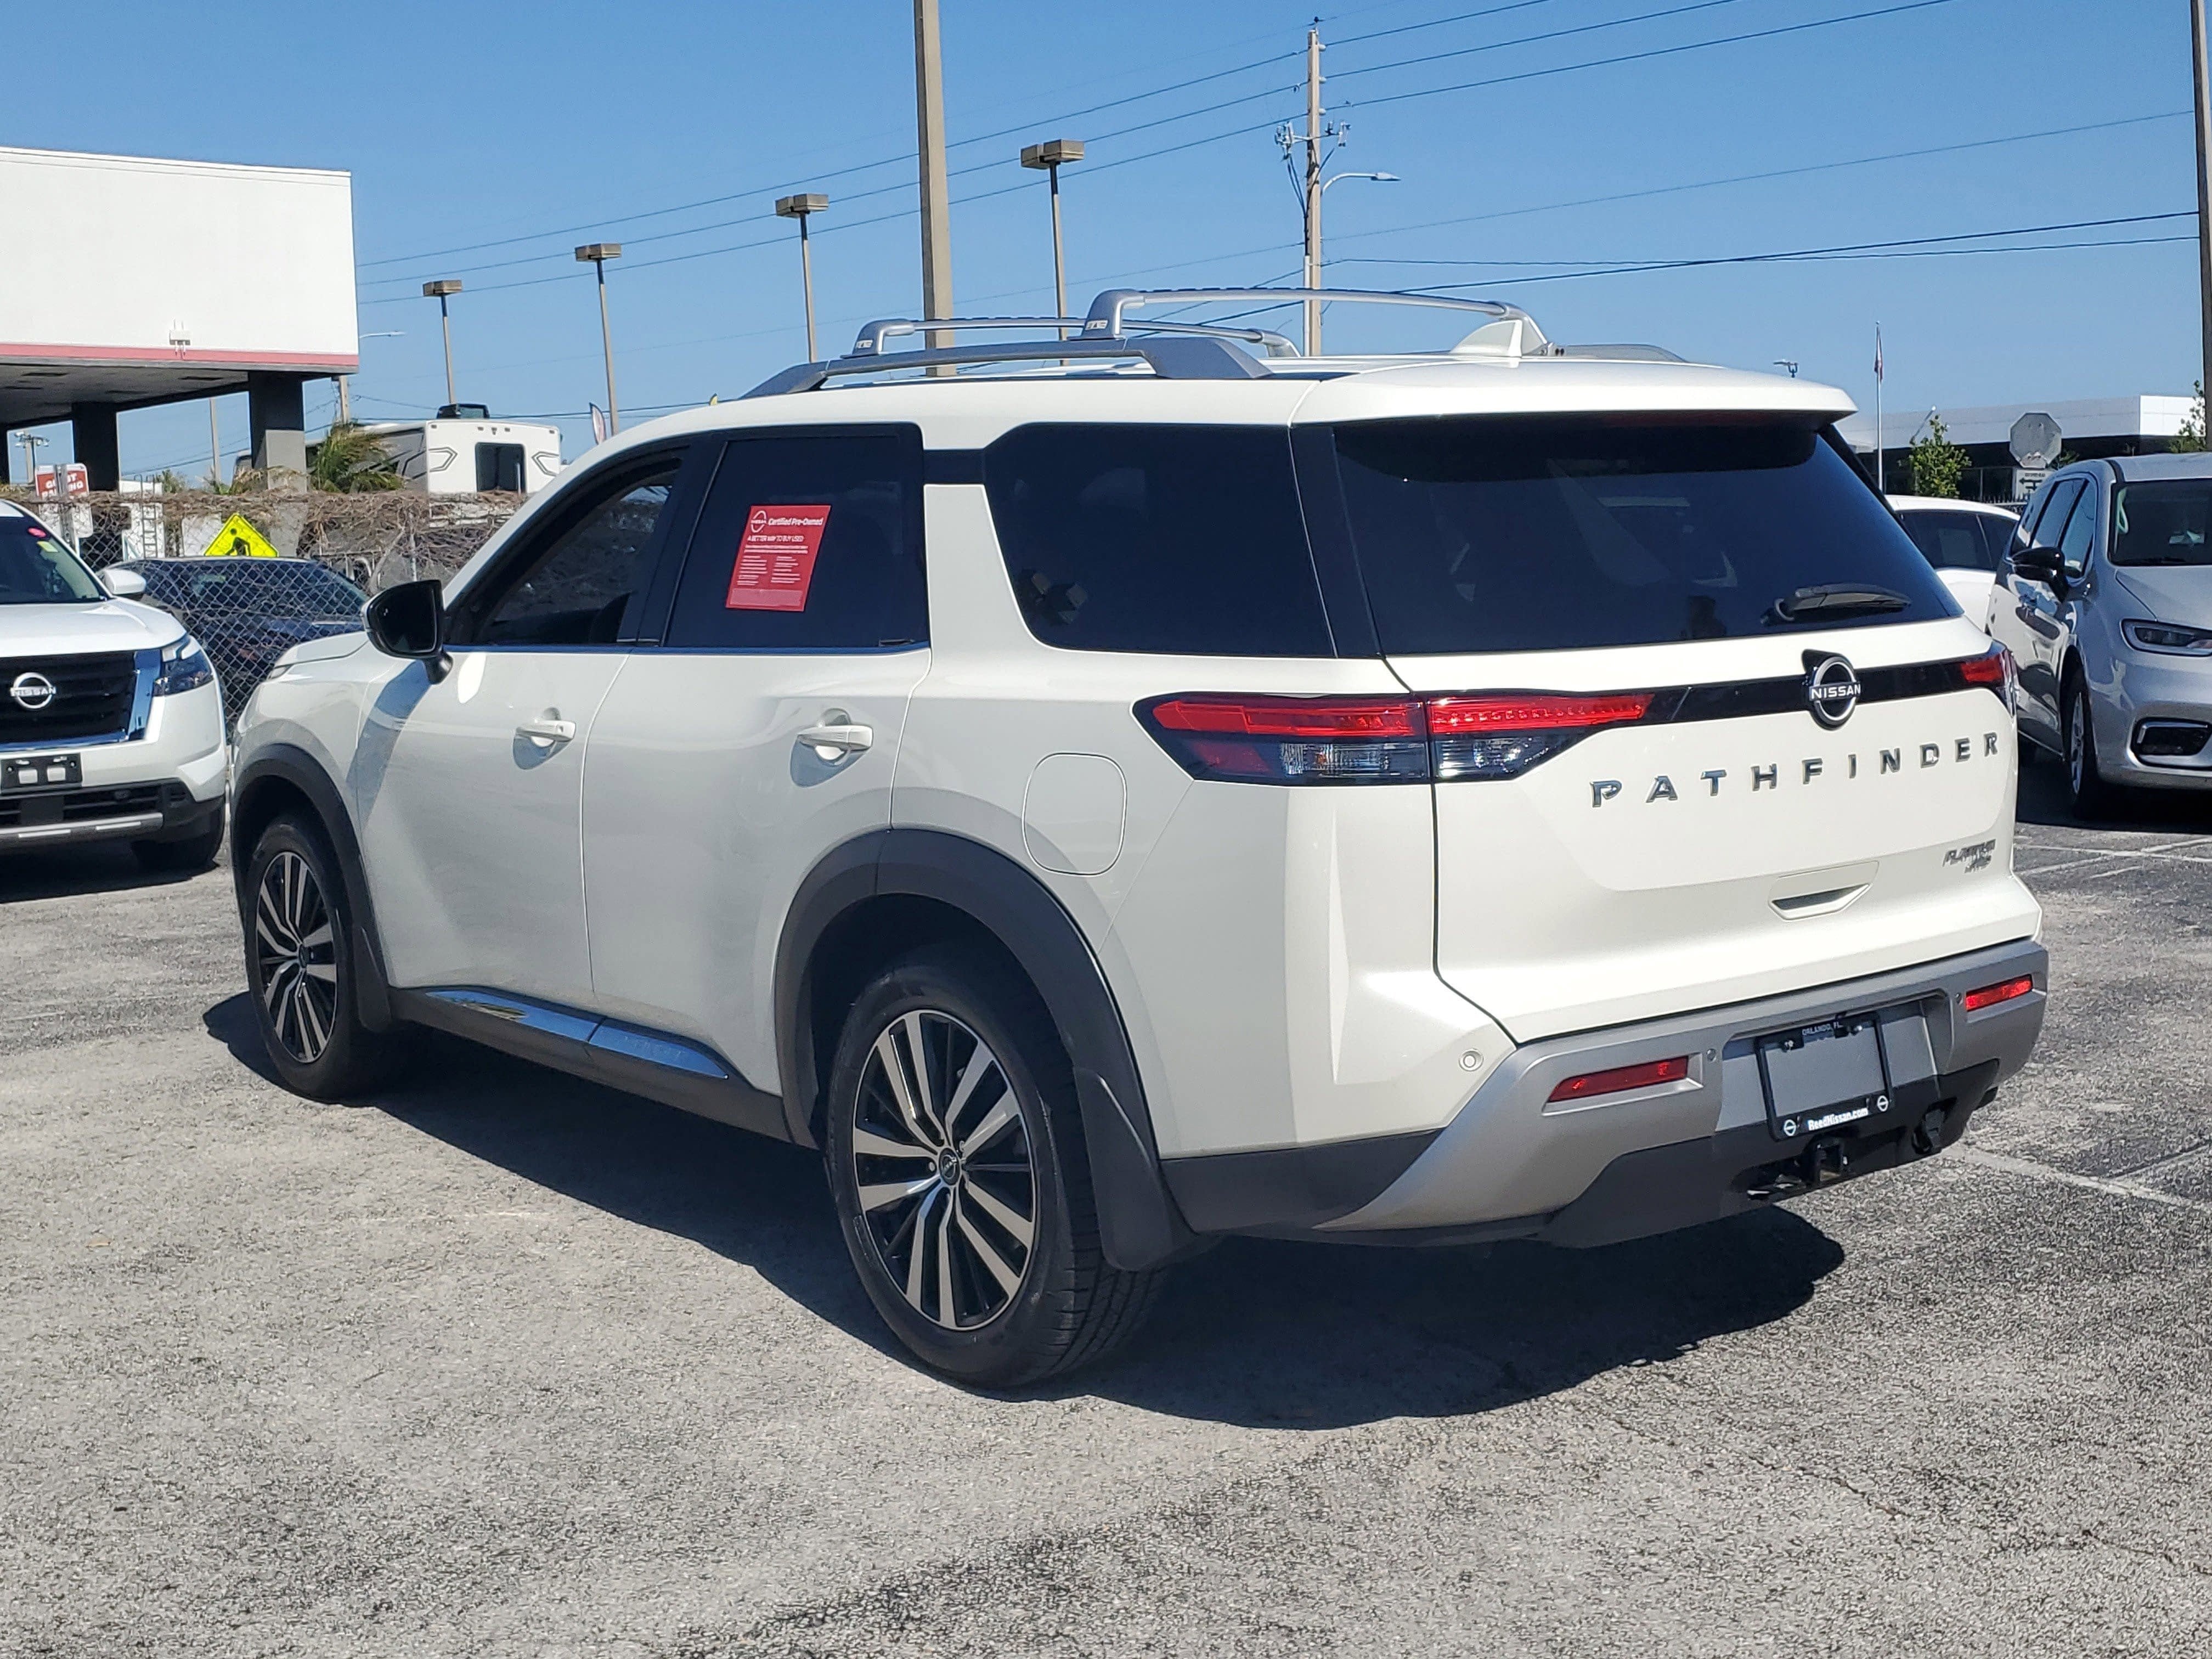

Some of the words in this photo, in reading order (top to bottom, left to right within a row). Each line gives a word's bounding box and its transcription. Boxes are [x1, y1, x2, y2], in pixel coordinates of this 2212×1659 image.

[10, 686, 57, 697] NISSAN
[1811, 683, 1861, 699] NISSAN
[1590, 732, 1998, 808] PATHFINDER
[1808, 1107, 1869, 1131] ReedNissan.com
